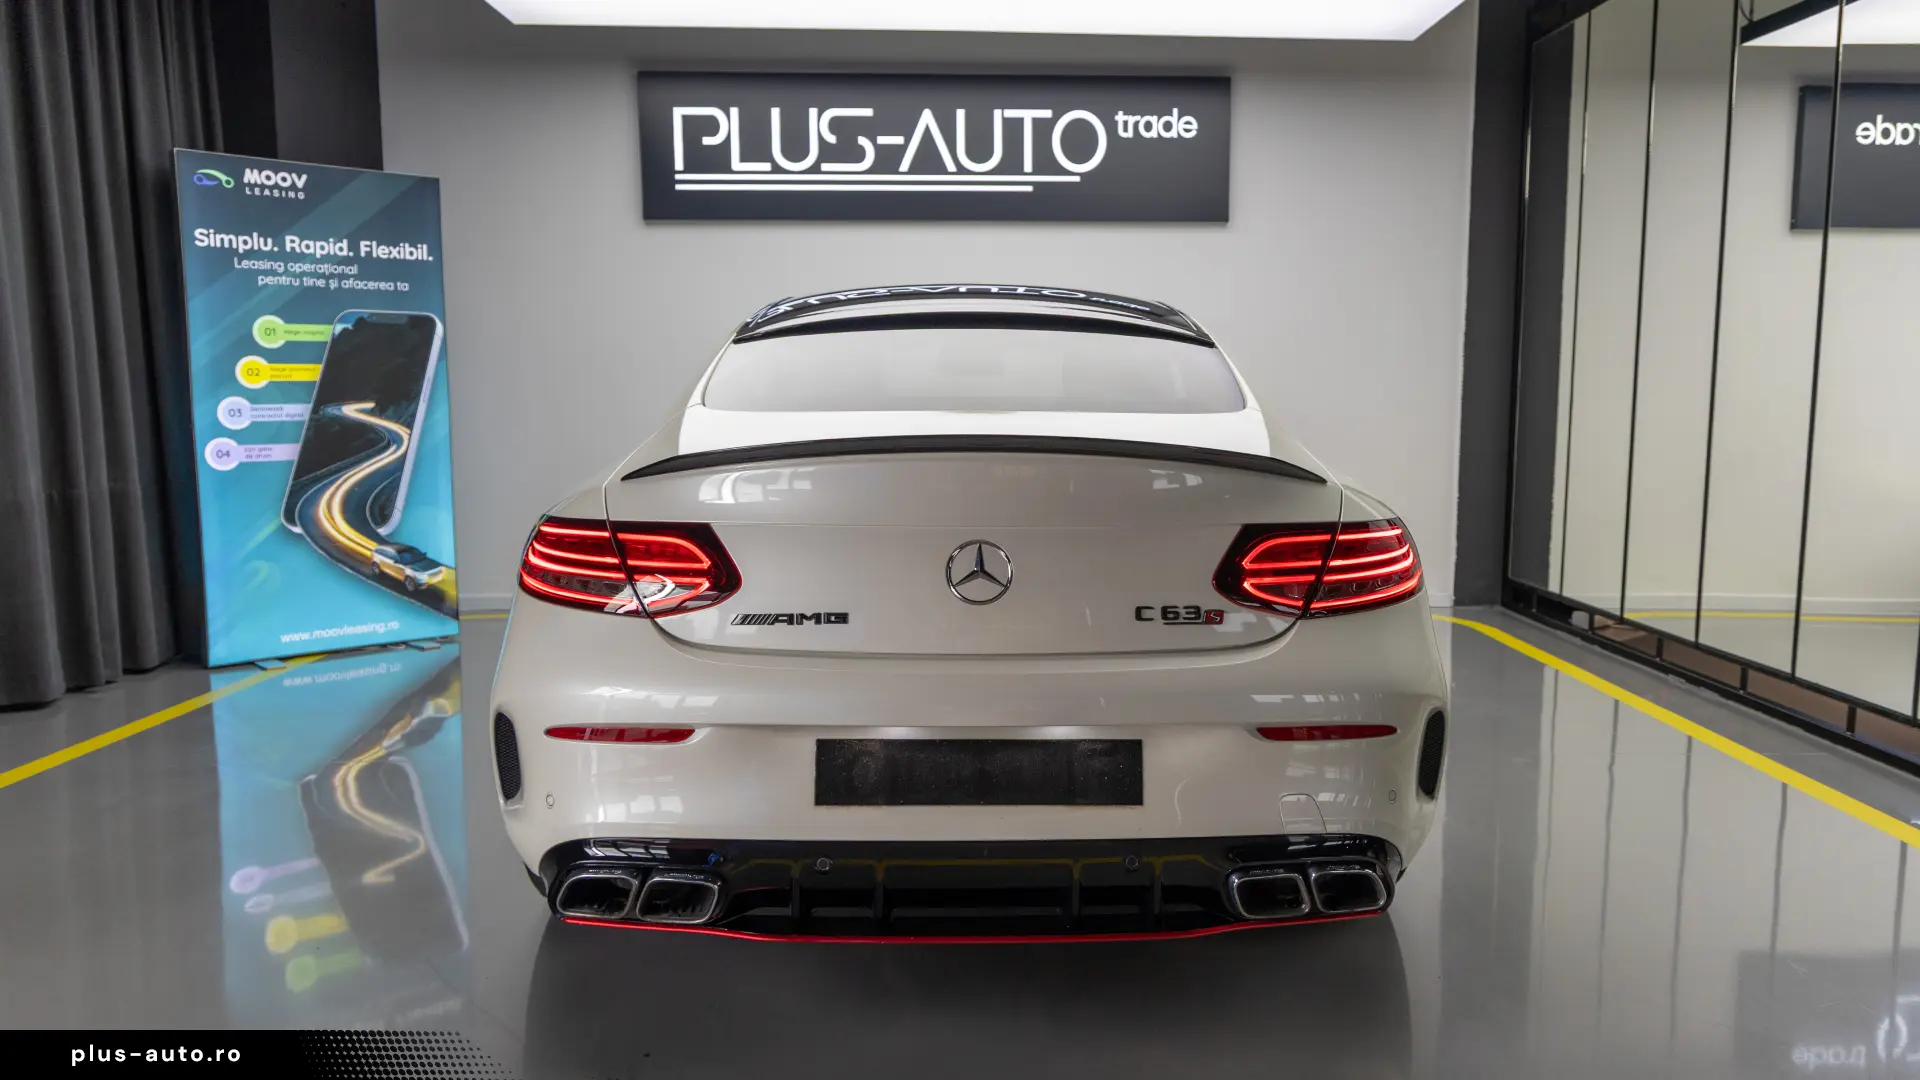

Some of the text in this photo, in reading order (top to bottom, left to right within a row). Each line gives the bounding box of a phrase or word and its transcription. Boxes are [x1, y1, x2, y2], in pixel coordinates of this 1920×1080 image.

[672, 106, 1198, 173] PLUS-AUTO trade
[243, 168, 308, 188] MOOV
[245, 187, 306, 200] LEASING
[193, 228, 434, 262] Simplu. Rapid. Flexibil.
[234, 257, 284, 273] Leasing
[257, 275, 300, 288] pentru
[302, 276, 324, 287] tine
[340, 278, 395, 290] afacerea
[396, 280, 410, 291] ta
[264, 328, 276, 337] 01
[246, 367, 260, 377] 02
[227, 408, 242, 418] 03
[215, 449, 230, 459] 04
[767, 612, 849, 626] AMG
[1135, 605, 1156, 622] C
[280, 621, 399, 643] www.moovleasing.ro
